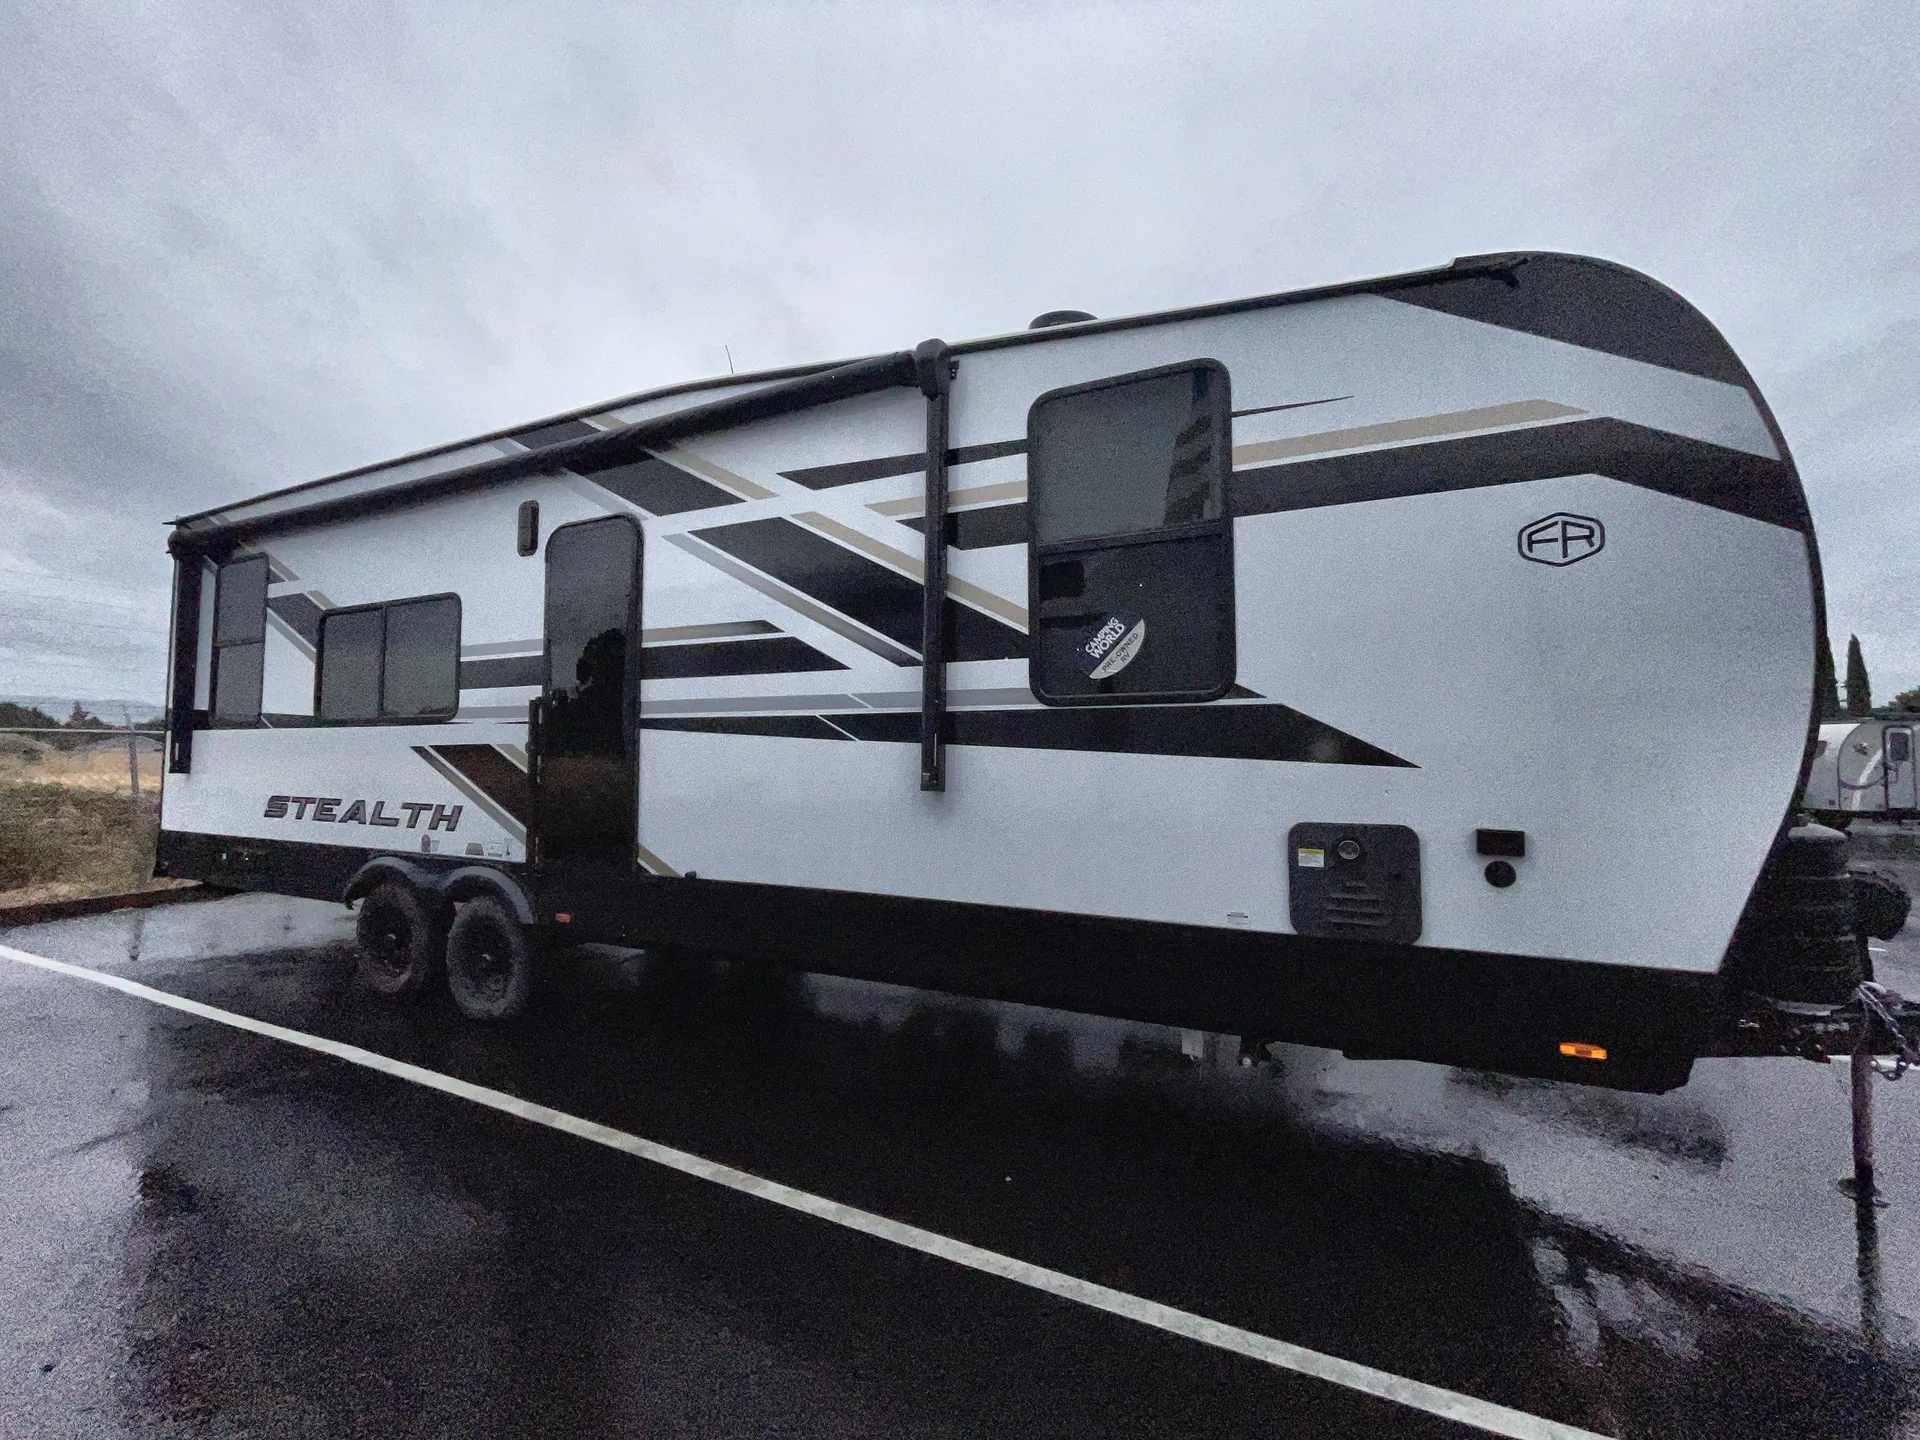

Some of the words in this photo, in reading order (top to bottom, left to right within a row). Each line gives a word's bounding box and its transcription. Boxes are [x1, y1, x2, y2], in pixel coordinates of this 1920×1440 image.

[1527, 520, 1595, 559] FR
[1085, 617, 1119, 653] CAMPING
[1090, 623, 1125, 659] WORLD
[1101, 633, 1139, 672] PRE-OWNED
[1120, 652, 1130, 663] RV
[263, 795, 463, 832] STEALTH
